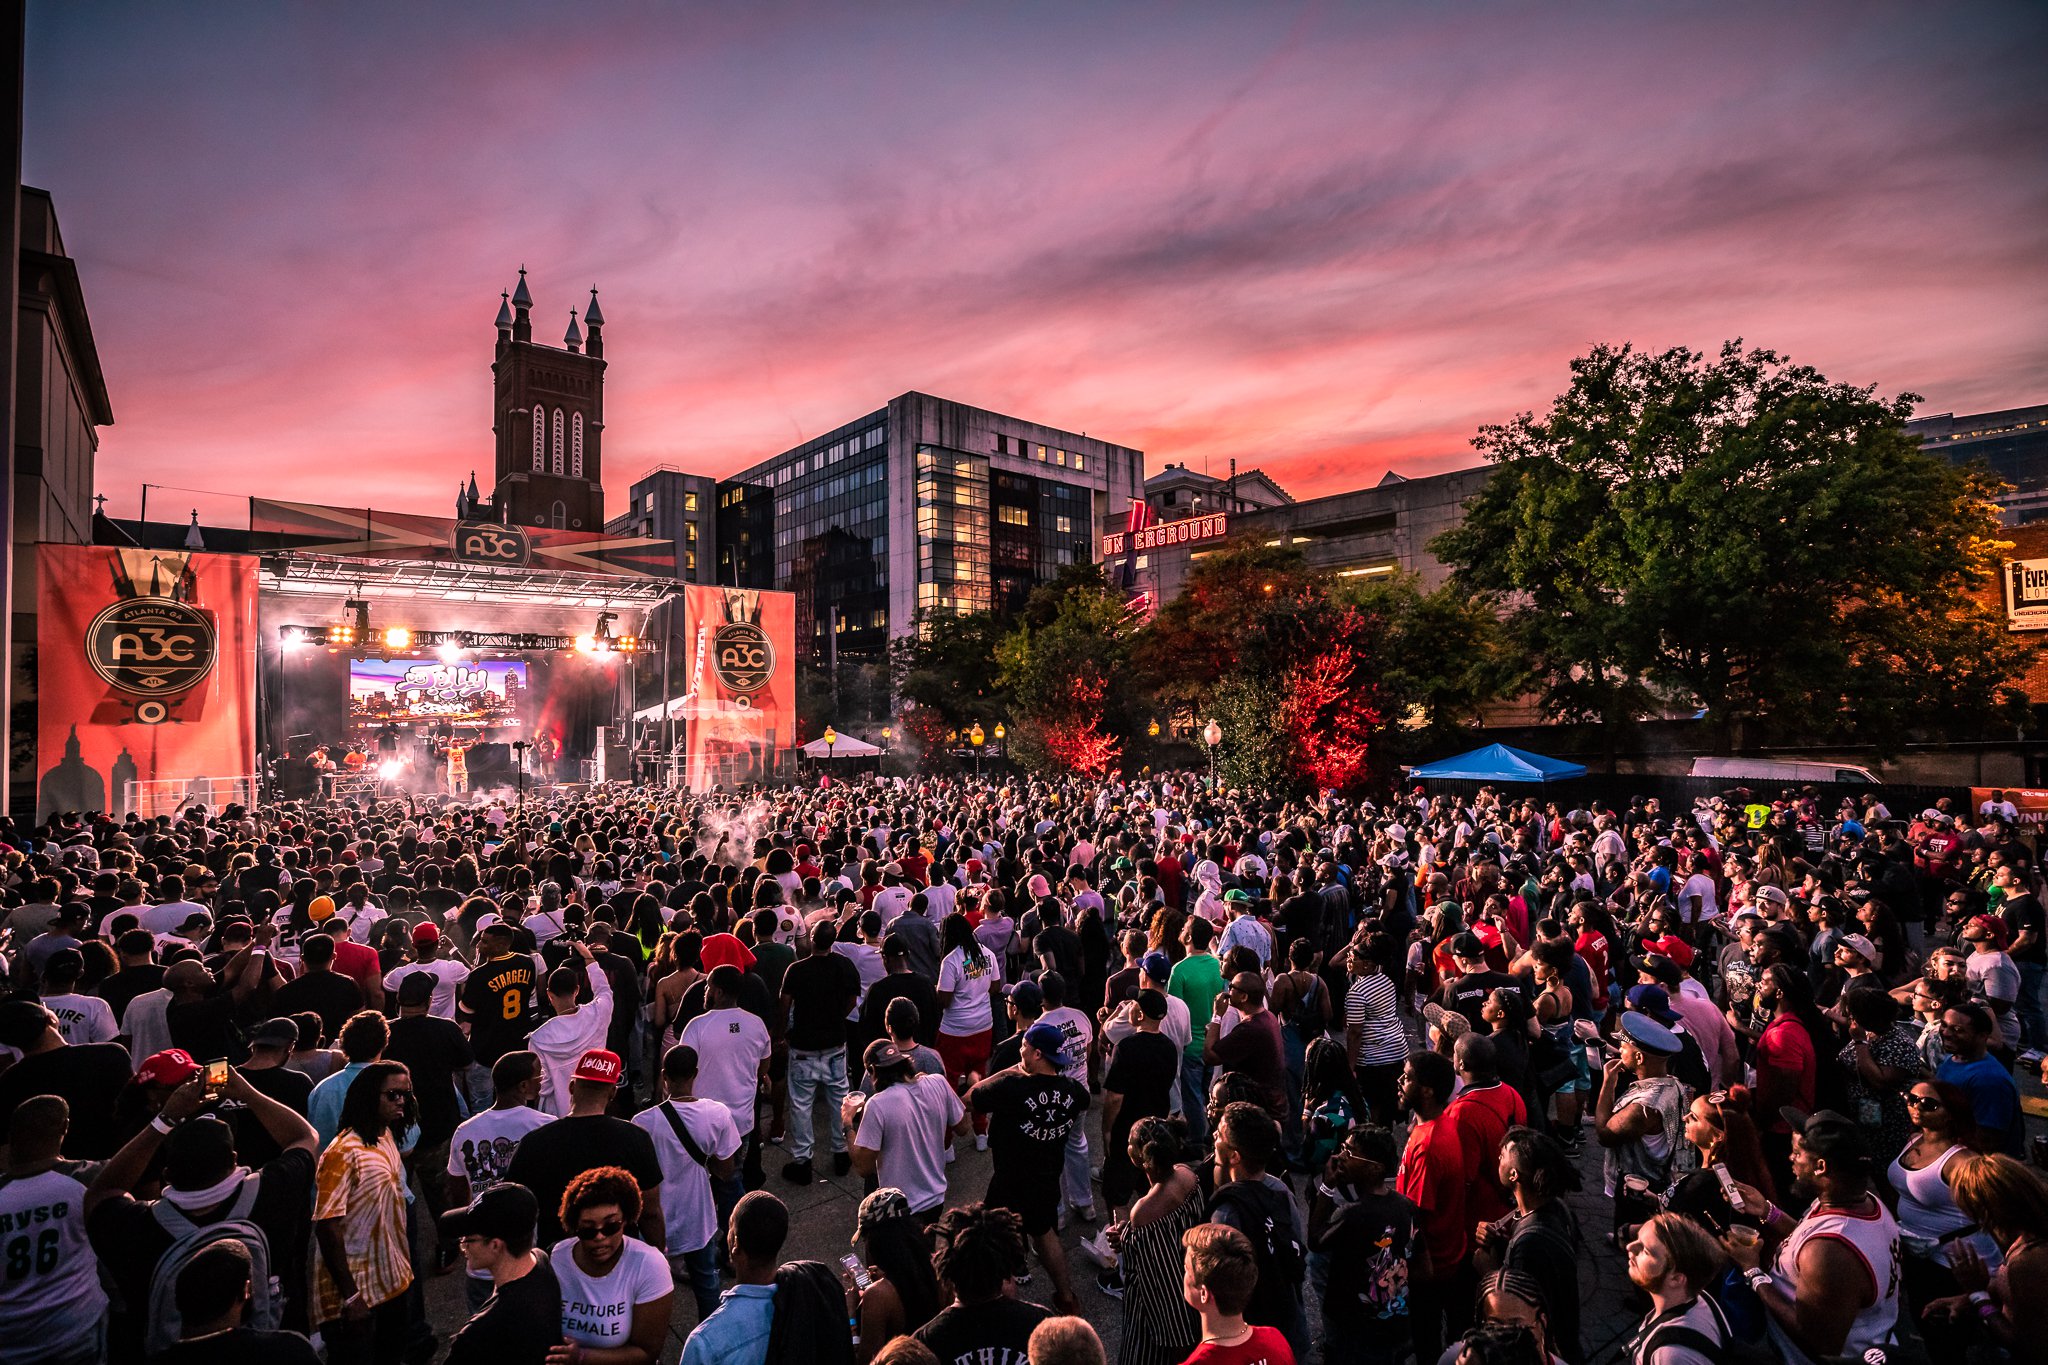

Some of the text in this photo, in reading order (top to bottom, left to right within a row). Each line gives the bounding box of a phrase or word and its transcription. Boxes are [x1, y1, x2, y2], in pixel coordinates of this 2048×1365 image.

[465, 532, 518, 559] A3C
[1103, 514, 1227, 555] UNERGROUND
[124, 608, 183, 620] ATLANTA GA
[112, 627, 195, 662] A3C
[722, 643, 766, 668] A3C
[502, 988, 521, 1020] 8
[50, 1008, 86, 1025] URE
[1025, 1090, 1074, 1111] BORN
[1046, 1109, 1056, 1122] X
[6, 1228, 60, 1281] 86
[570, 1301, 626, 1318] FUTURE
[561, 1316, 621, 1336] FEMALE
